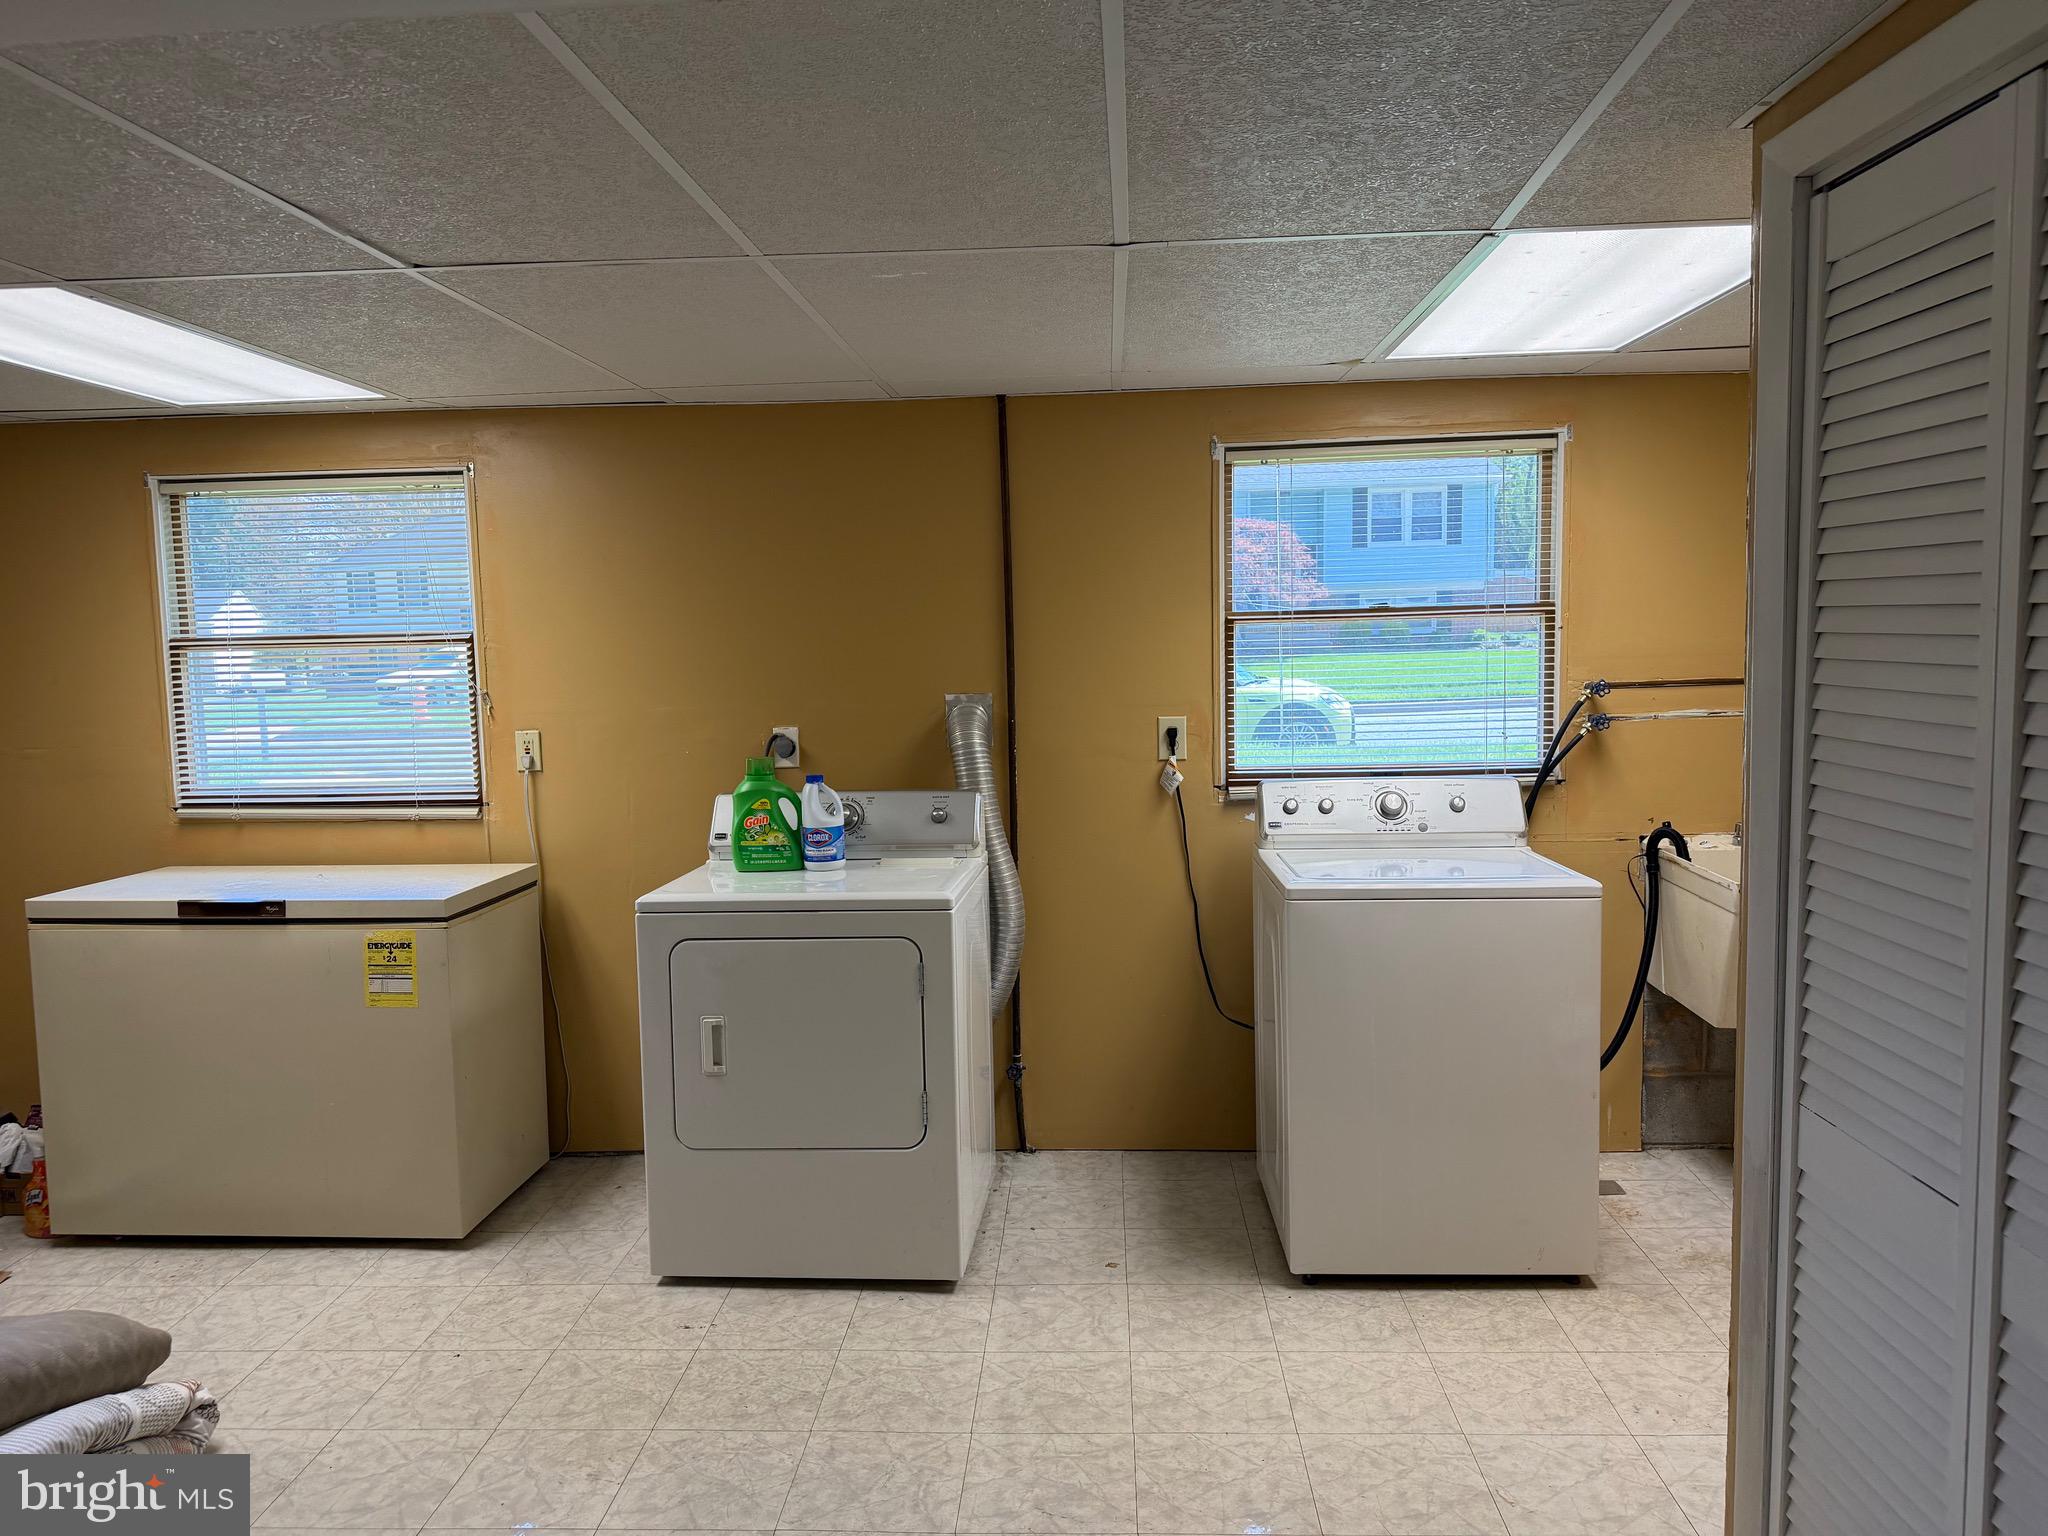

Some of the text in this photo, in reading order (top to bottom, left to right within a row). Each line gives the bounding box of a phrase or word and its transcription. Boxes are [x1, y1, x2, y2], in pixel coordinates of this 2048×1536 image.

[744, 815, 769, 829] Gain
[807, 834, 829, 842] CLOROX
[367, 942, 412, 950] ENERGYGUIDE
